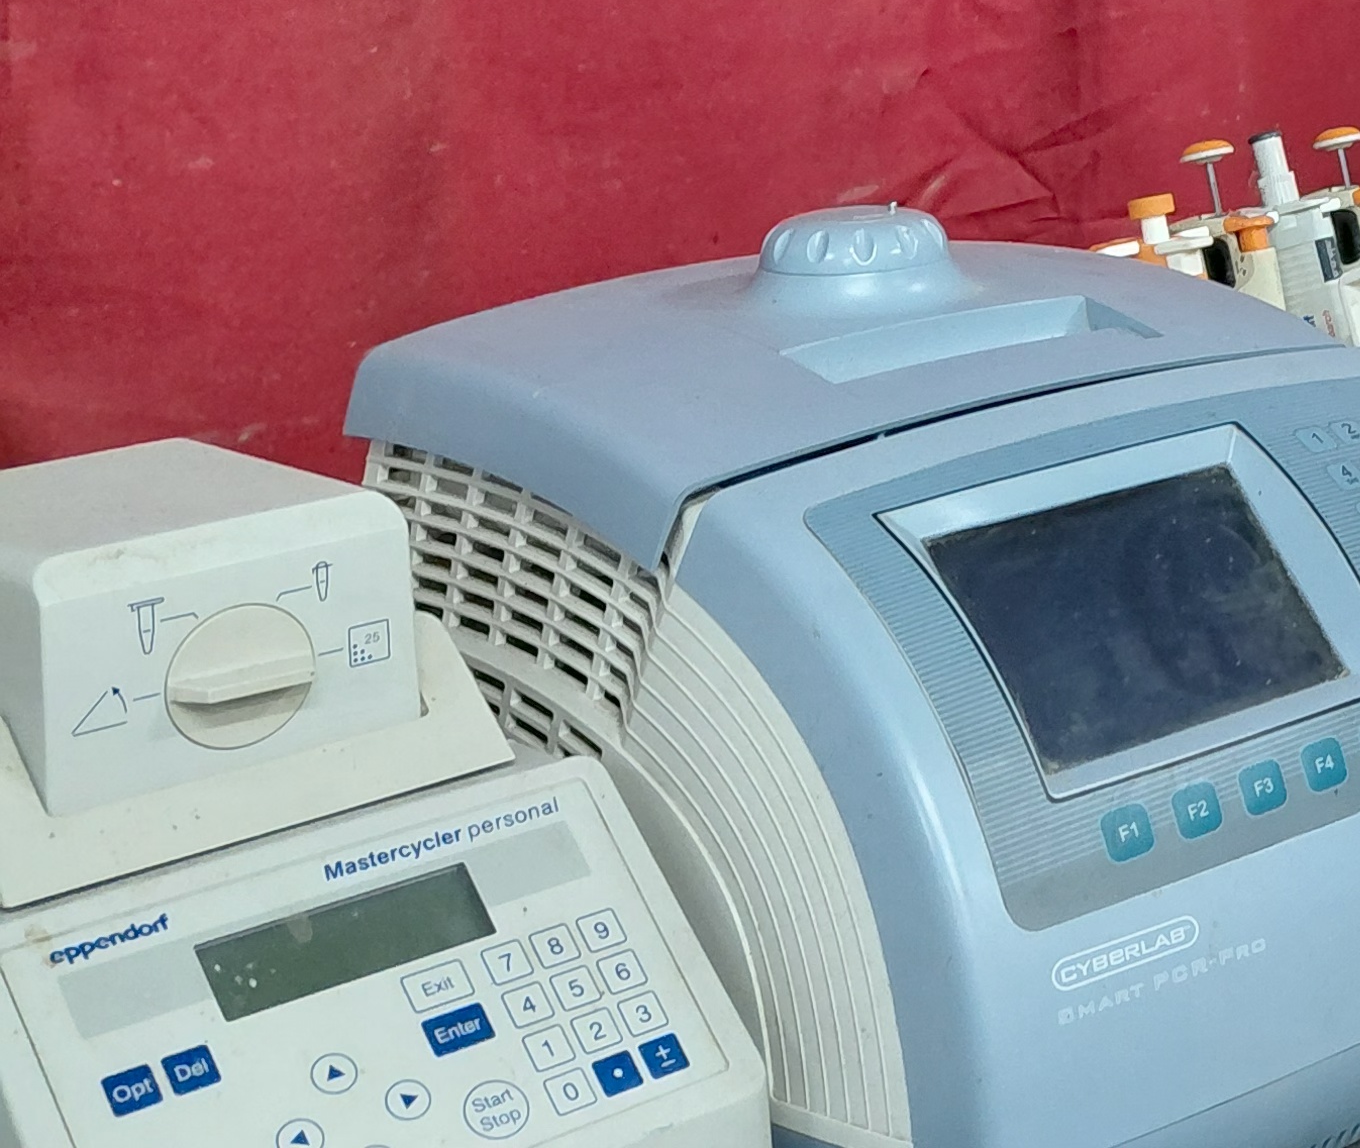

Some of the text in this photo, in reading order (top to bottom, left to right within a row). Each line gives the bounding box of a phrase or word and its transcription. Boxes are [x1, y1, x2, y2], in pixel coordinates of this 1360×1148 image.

[1311, 432, 1324, 444] 1
[1341, 422, 1356, 435] 2
[1341, 464, 1352, 478] 4
[364, 631, 381, 646] 25
[1314, 754, 1335, 775] F4
[1253, 778, 1274, 799] F3
[1187, 801, 1210, 822] F2
[323, 796, 560, 882] Mastercycler personal
[1118, 821, 1141, 842] F1
[49, 913, 169, 965] eppendorf
[593, 921, 610, 940] 9
[547, 937, 564, 956] 8
[1060, 926, 1188, 984] CYBERLAB
[498, 953, 512, 973] 7
[614, 962, 632, 981] 6
[1153, 938, 1267, 991] PCR-PRO
[421, 975, 456, 998] Exit
[568, 979, 585, 998] 5
[521, 996, 537, 1014] 4
[635, 1004, 652, 1024] 3
[433, 1016, 482, 1045] Enter
[588, 1022, 607, 1042] 2
[541, 1039, 555, 1058] 1
[174, 1058, 210, 1083] Del
[112, 1078, 154, 1104] Opt
[472, 1088, 514, 1114] Start
[562, 1082, 580, 1102] 0
[479, 1108, 522, 1133] Stop
